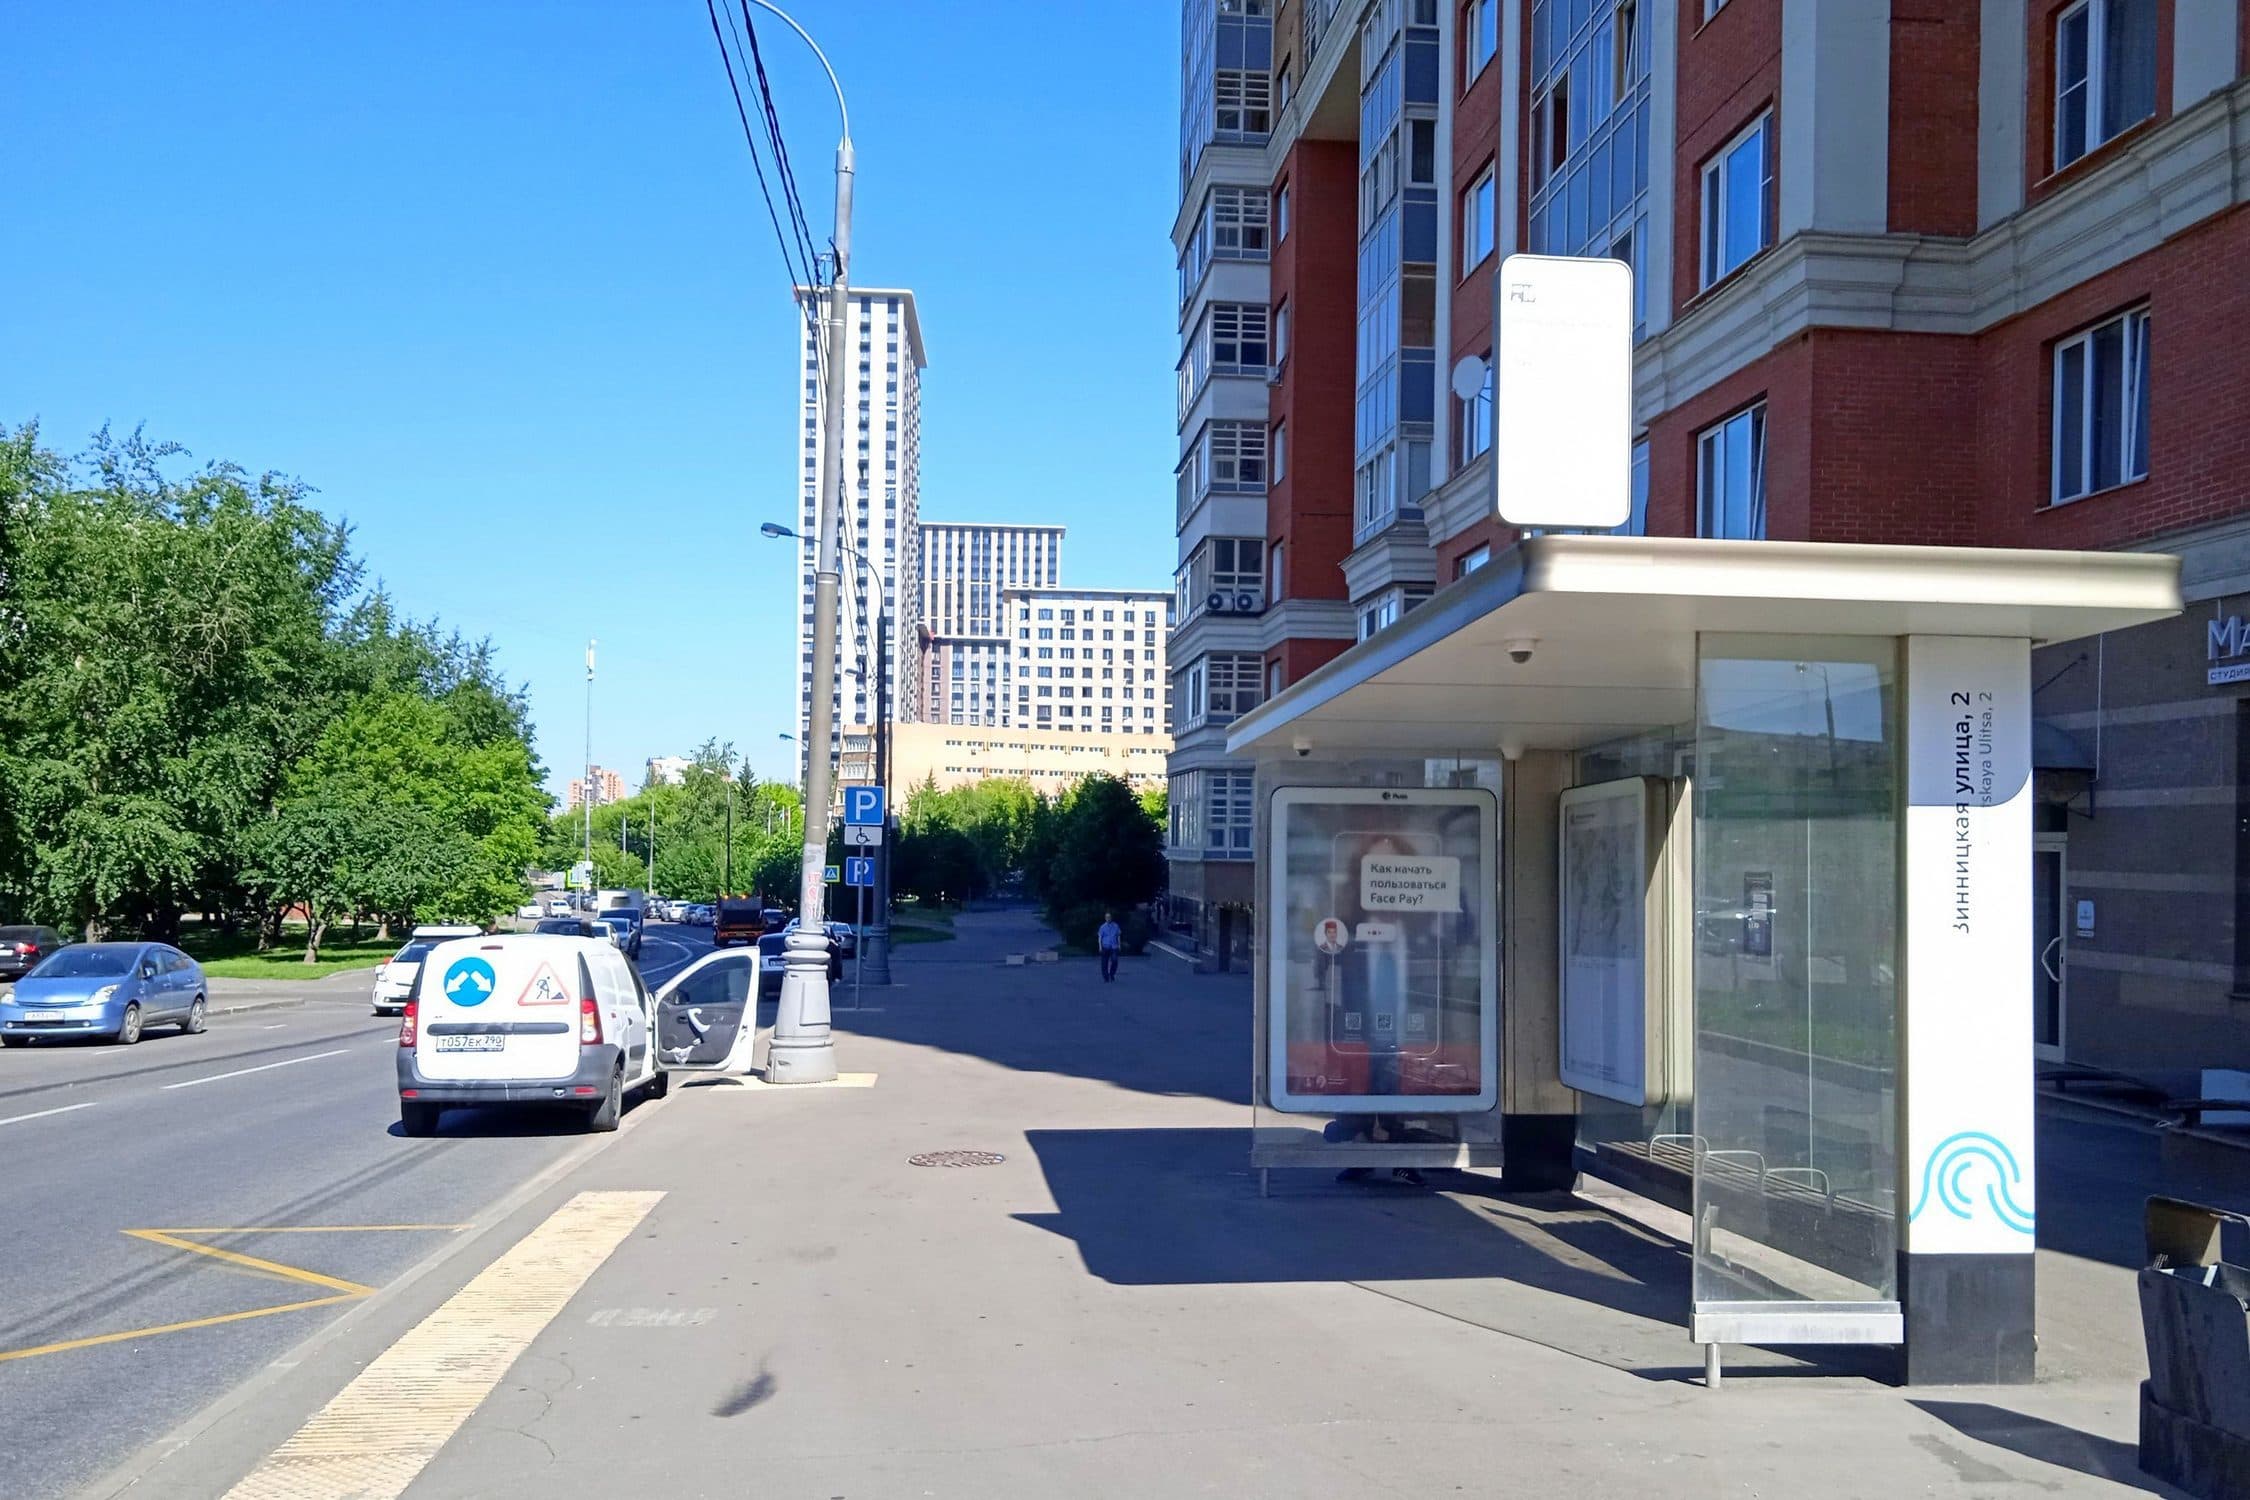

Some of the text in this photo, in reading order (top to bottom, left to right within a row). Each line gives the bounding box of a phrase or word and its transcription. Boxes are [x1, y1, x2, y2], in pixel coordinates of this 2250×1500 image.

[1951, 691, 1970, 706] 2
[1980, 691, 1992, 701] 2
[1955, 713, 1974, 794] улица,
[1979, 761, 1995, 807] skaya
[855, 791, 877, 821] P
[1370, 863, 1432, 875] Как начать
[1370, 880, 1447, 890] пользоваться
[1370, 893, 1424, 906] Face Pay?
